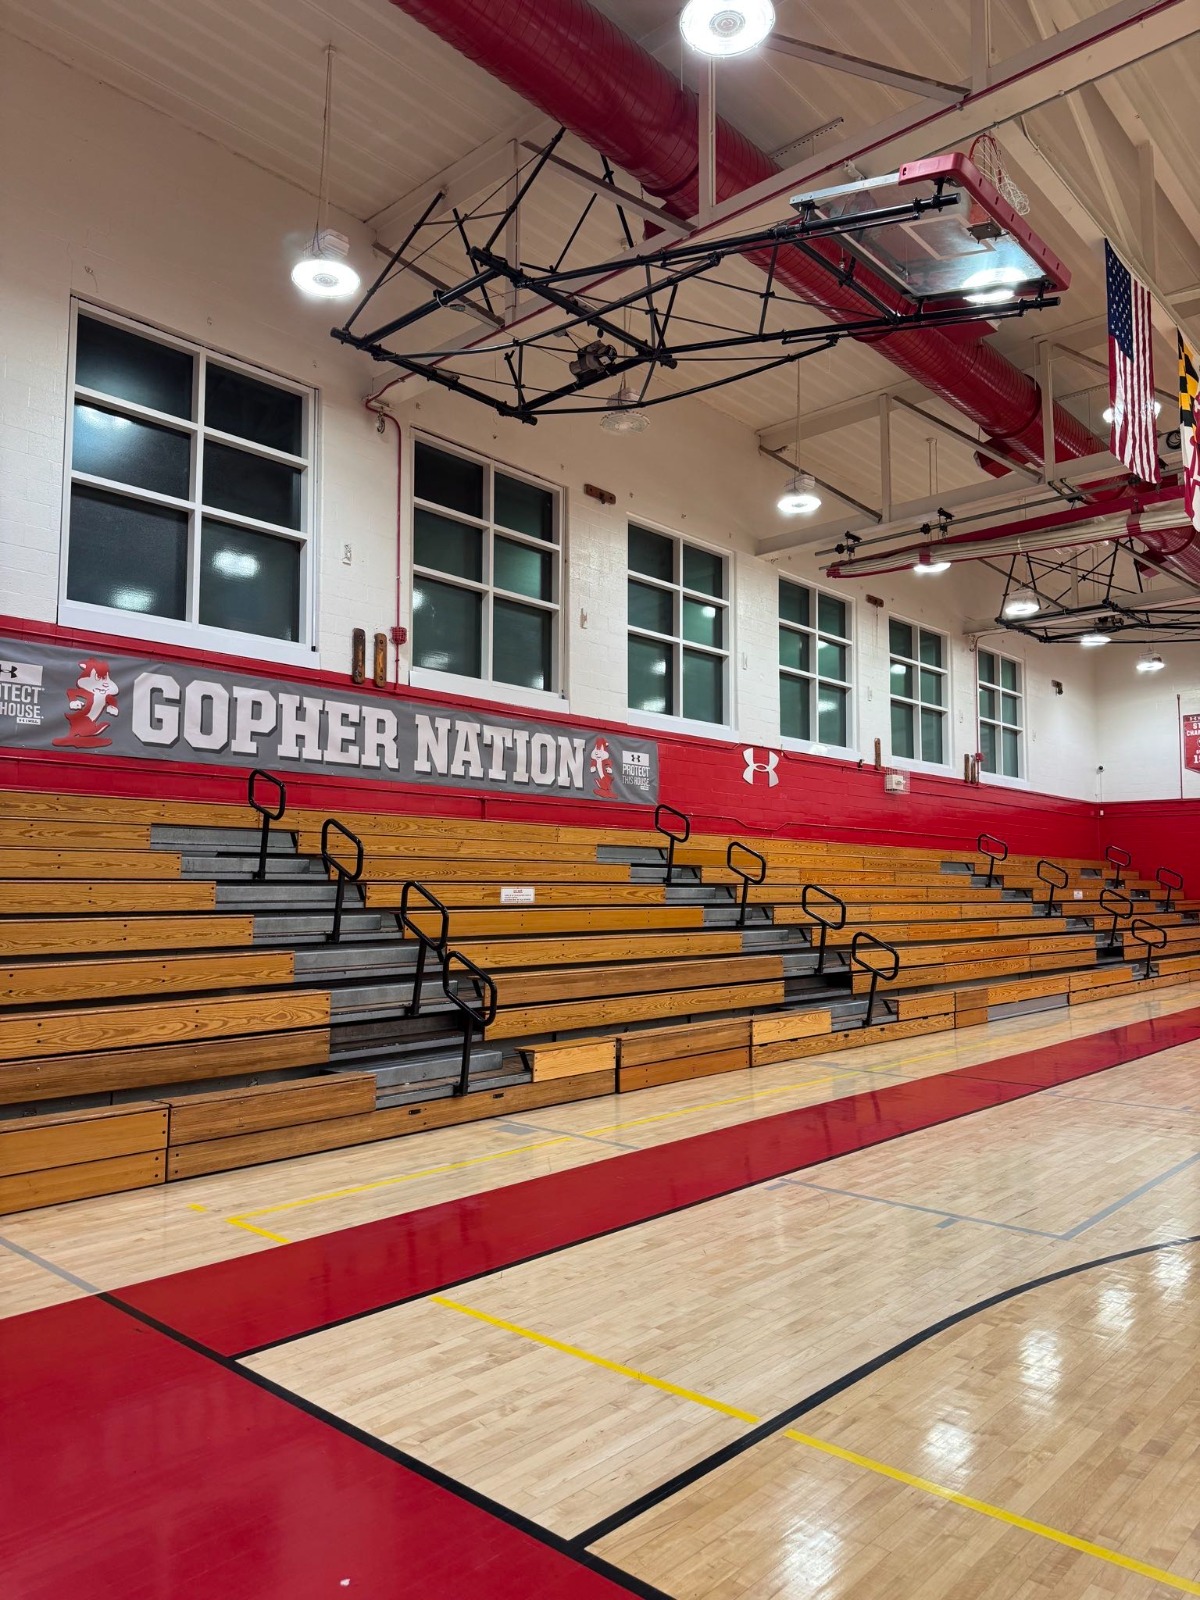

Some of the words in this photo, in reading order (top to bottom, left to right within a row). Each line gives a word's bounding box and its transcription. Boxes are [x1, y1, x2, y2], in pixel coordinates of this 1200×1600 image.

[132, 672, 399, 770] GOPHER
[414, 714, 586, 789] NATION
[622, 764, 650, 778] PROTECT
